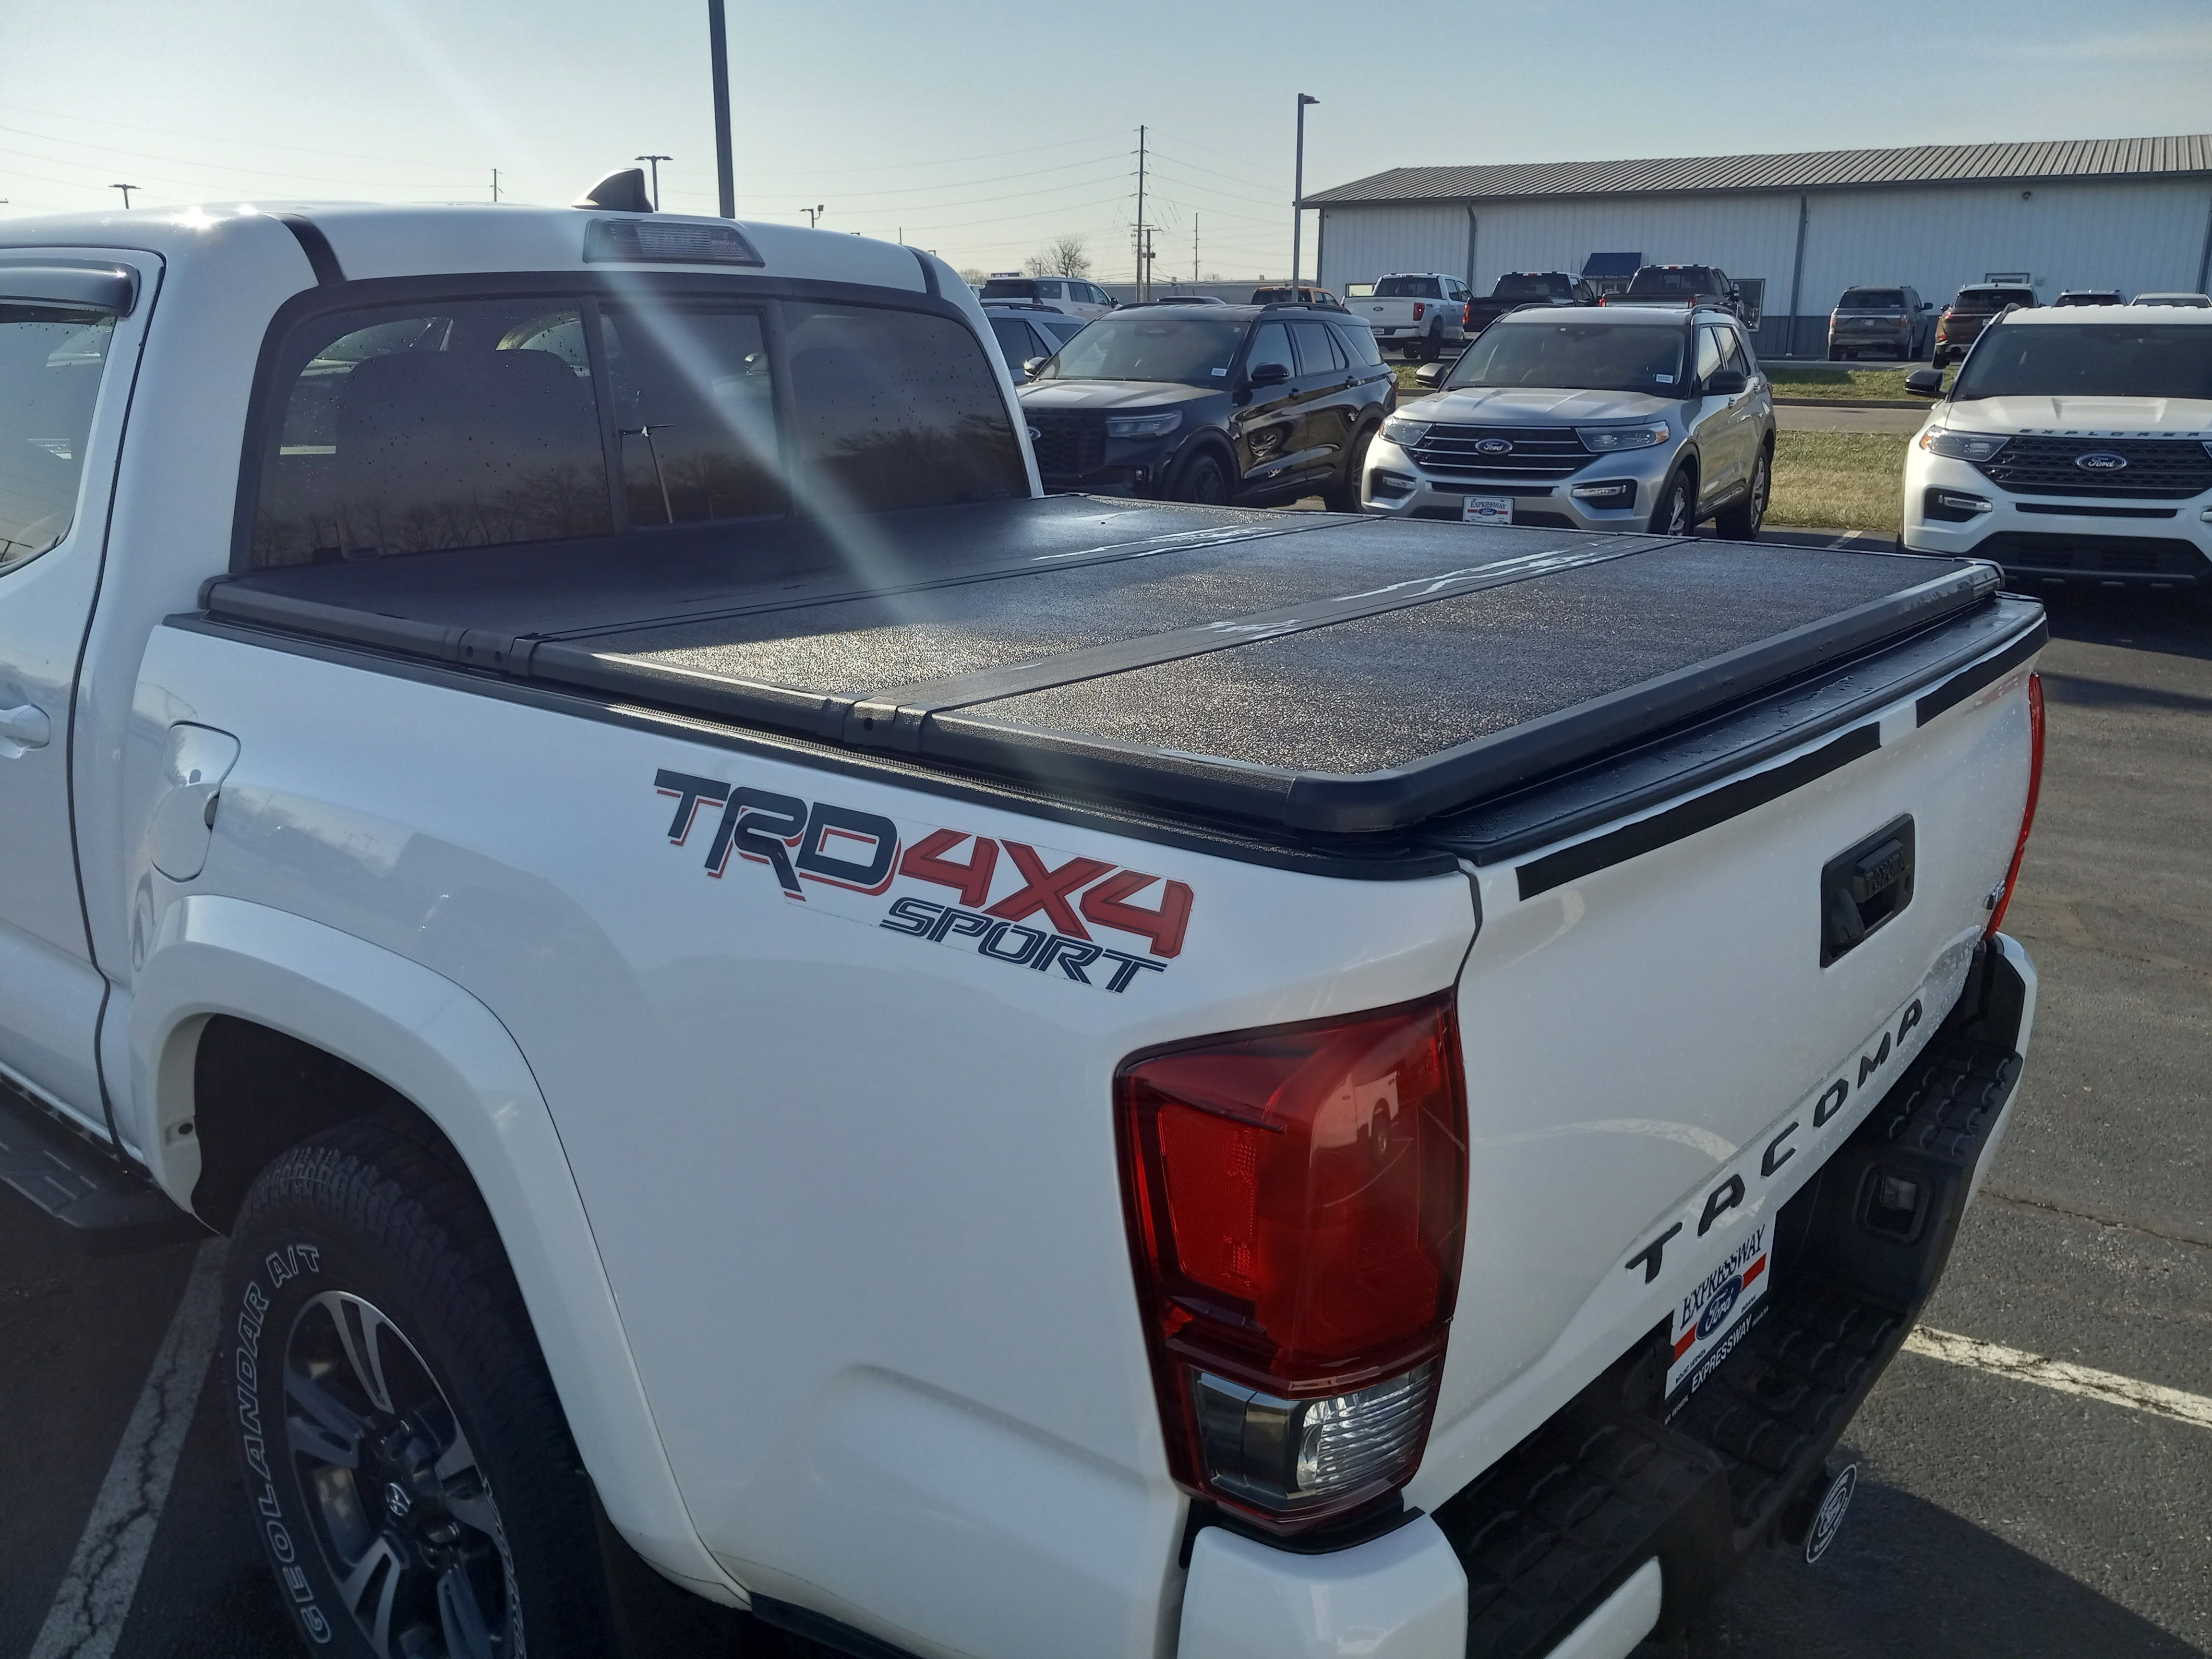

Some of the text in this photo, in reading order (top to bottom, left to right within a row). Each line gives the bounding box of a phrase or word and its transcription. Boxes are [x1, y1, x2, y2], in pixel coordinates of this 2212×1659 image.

[1483, 442, 1504, 451] Ford
[2088, 457, 2115, 468] Ford
[1470, 500, 1506, 509] EXPRESSWAY
[654, 769, 901, 902] TRD
[879, 897, 1166, 994] SPORT
[1625, 998, 1923, 1284] TACOMA
[1680, 1224, 1766, 1331] EXPRESSWAY
[1705, 1286, 1734, 1332] Ford
[1691, 1313, 1752, 1394] EXPRESSWAY
[236, 1243, 332, 1644] GEOLANDAR A/T
